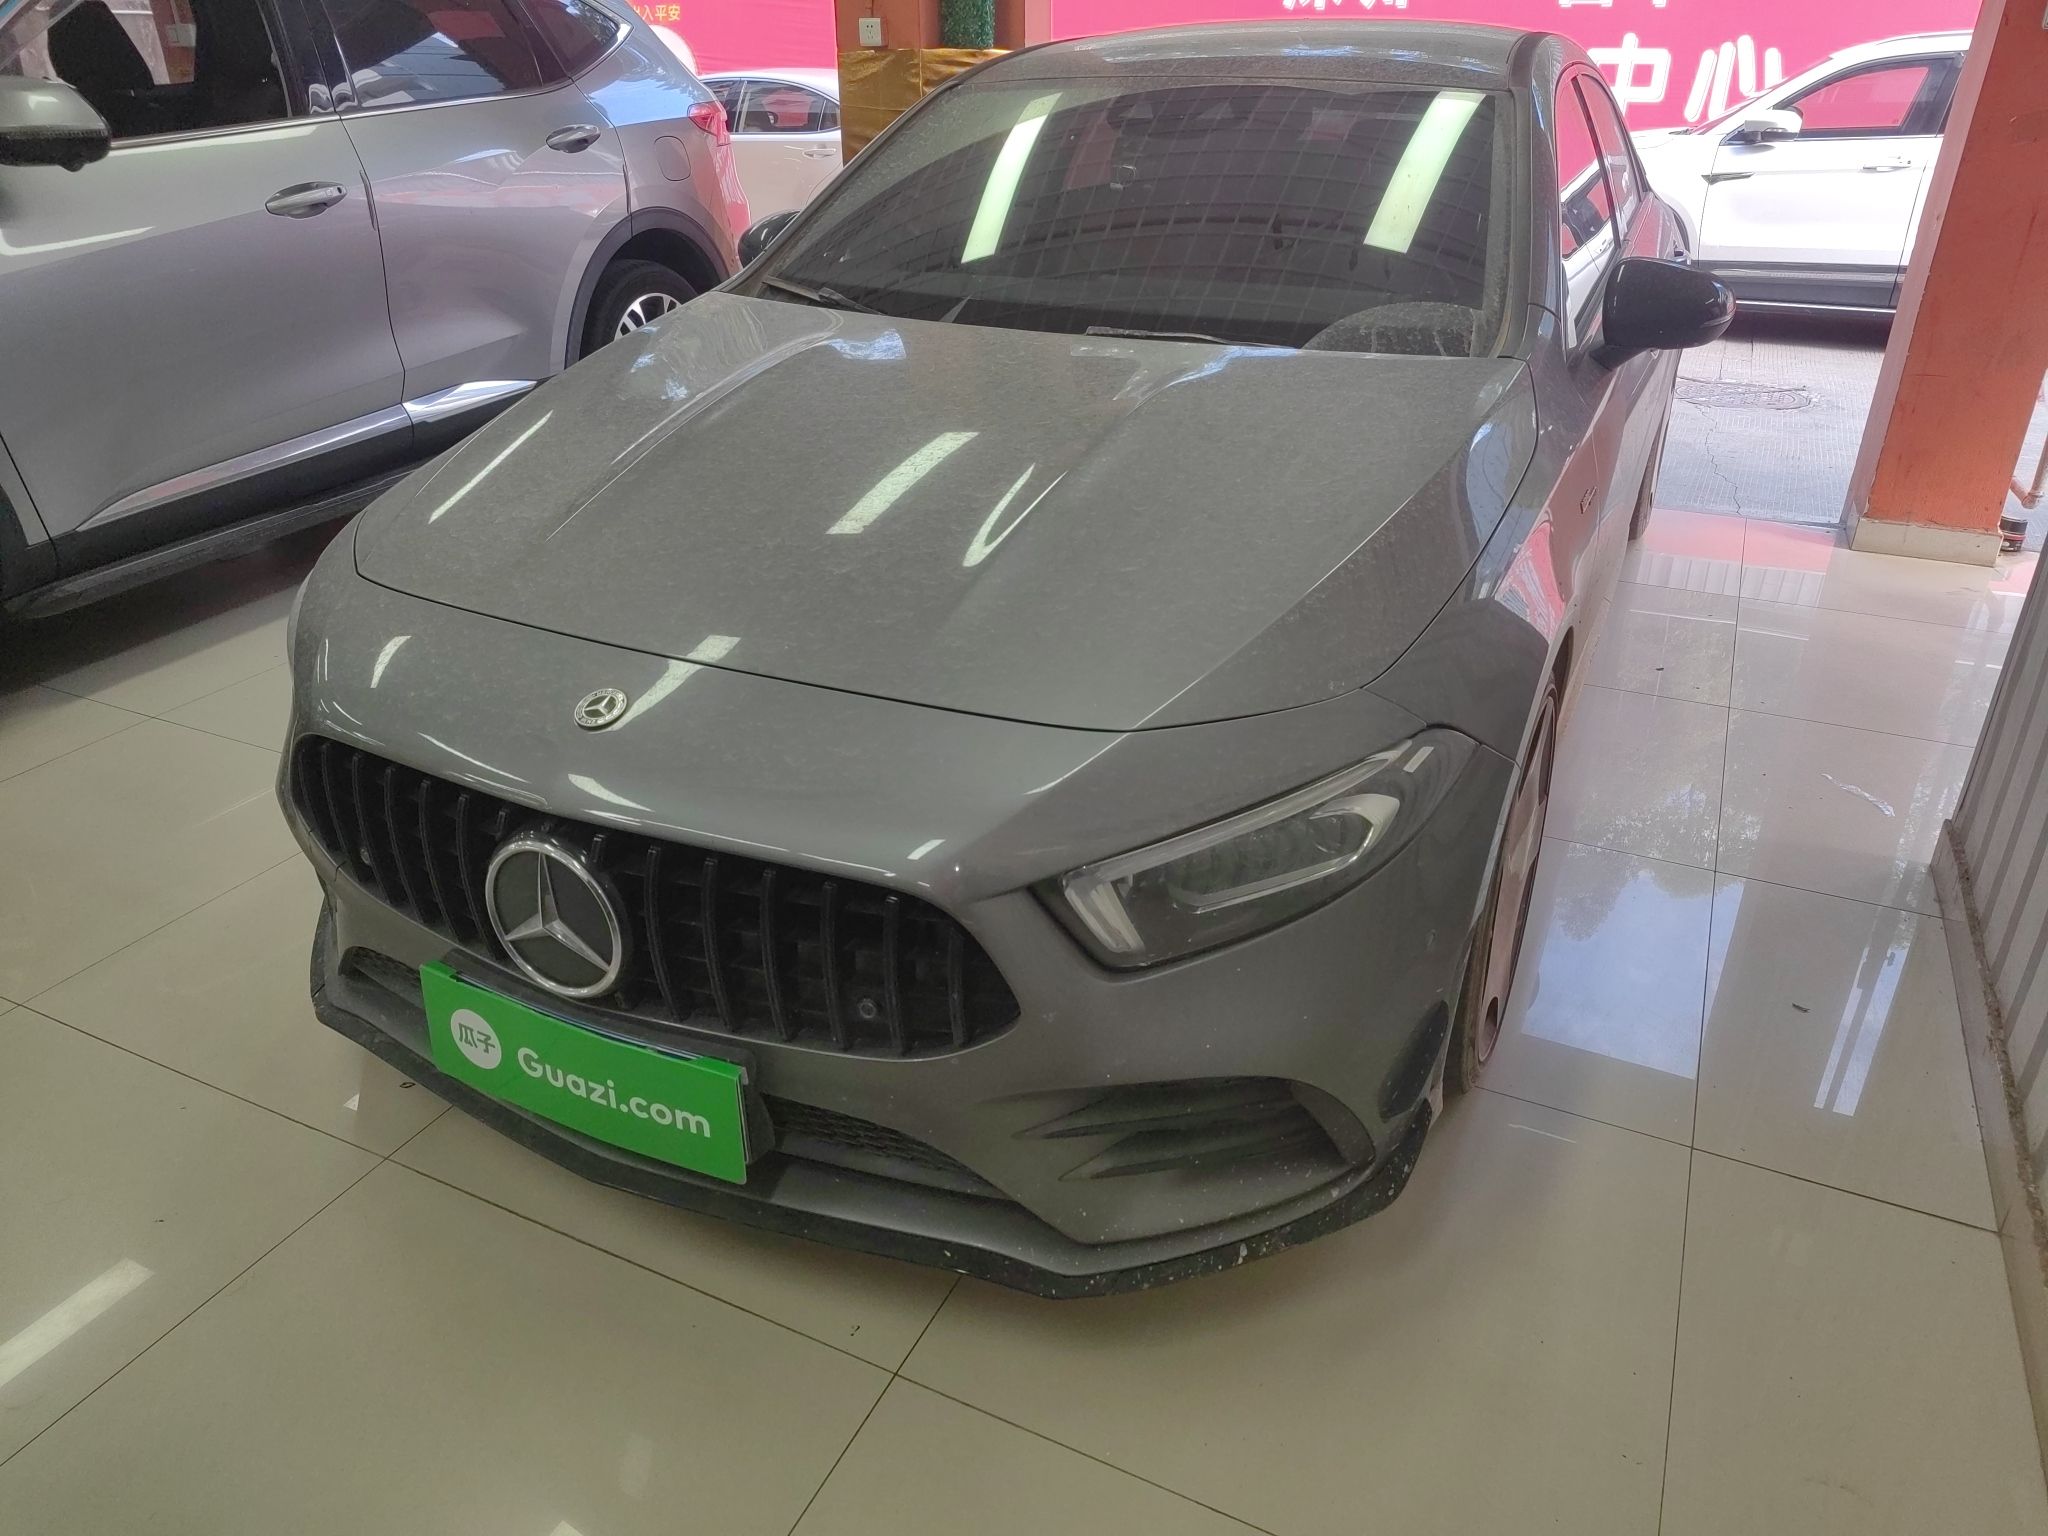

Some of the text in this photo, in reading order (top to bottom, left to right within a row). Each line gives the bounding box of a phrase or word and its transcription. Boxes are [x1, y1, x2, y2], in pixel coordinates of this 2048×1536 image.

[1587, 32, 1783, 122] 中心
[458, 1022, 496, 1054] 瓜子
[517, 1047, 711, 1138] Guazi.com
